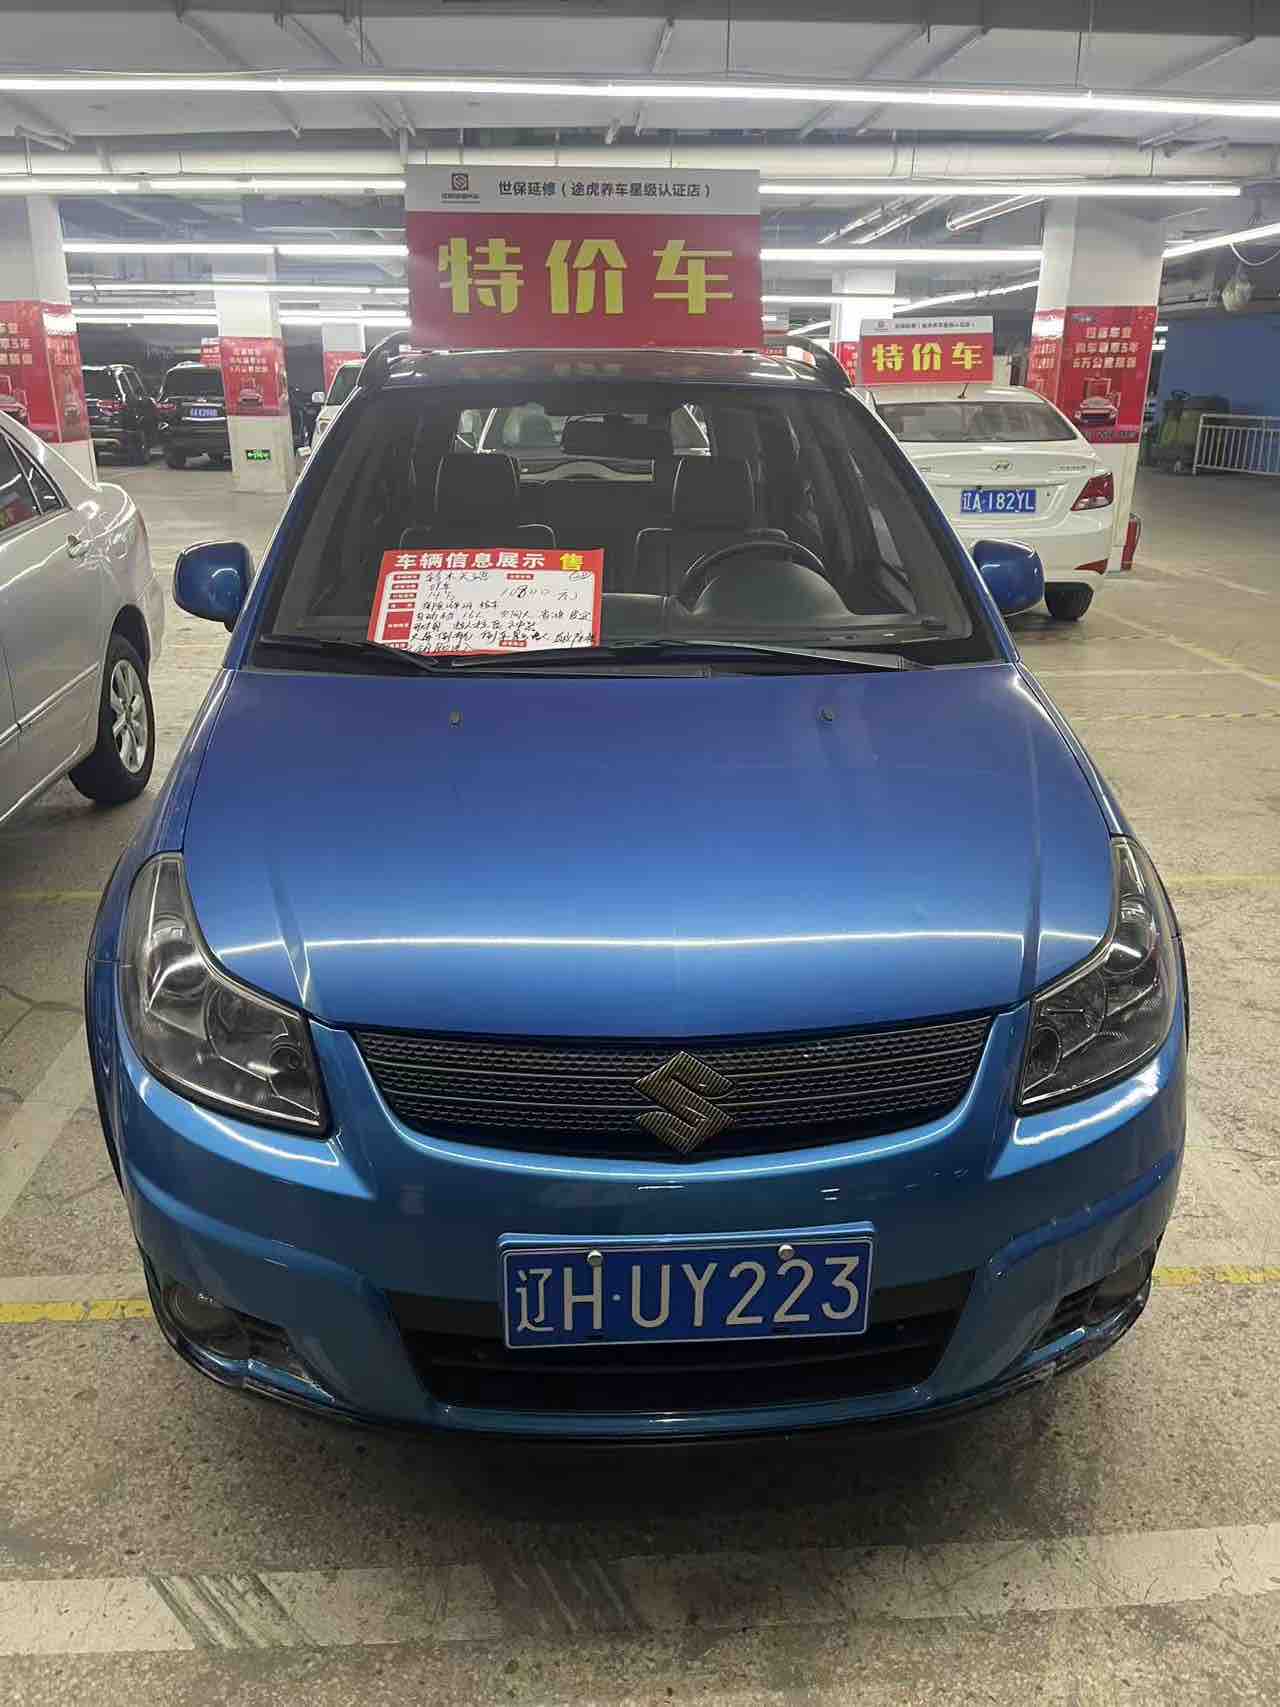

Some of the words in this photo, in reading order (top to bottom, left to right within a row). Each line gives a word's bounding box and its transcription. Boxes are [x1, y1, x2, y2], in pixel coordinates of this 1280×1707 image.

[438, 238, 733, 314] 特价车
[872, 342, 983, 371] 特价车
[394, 552, 545, 570] 车辆信息展示
[559, 553, 585, 572] 售
